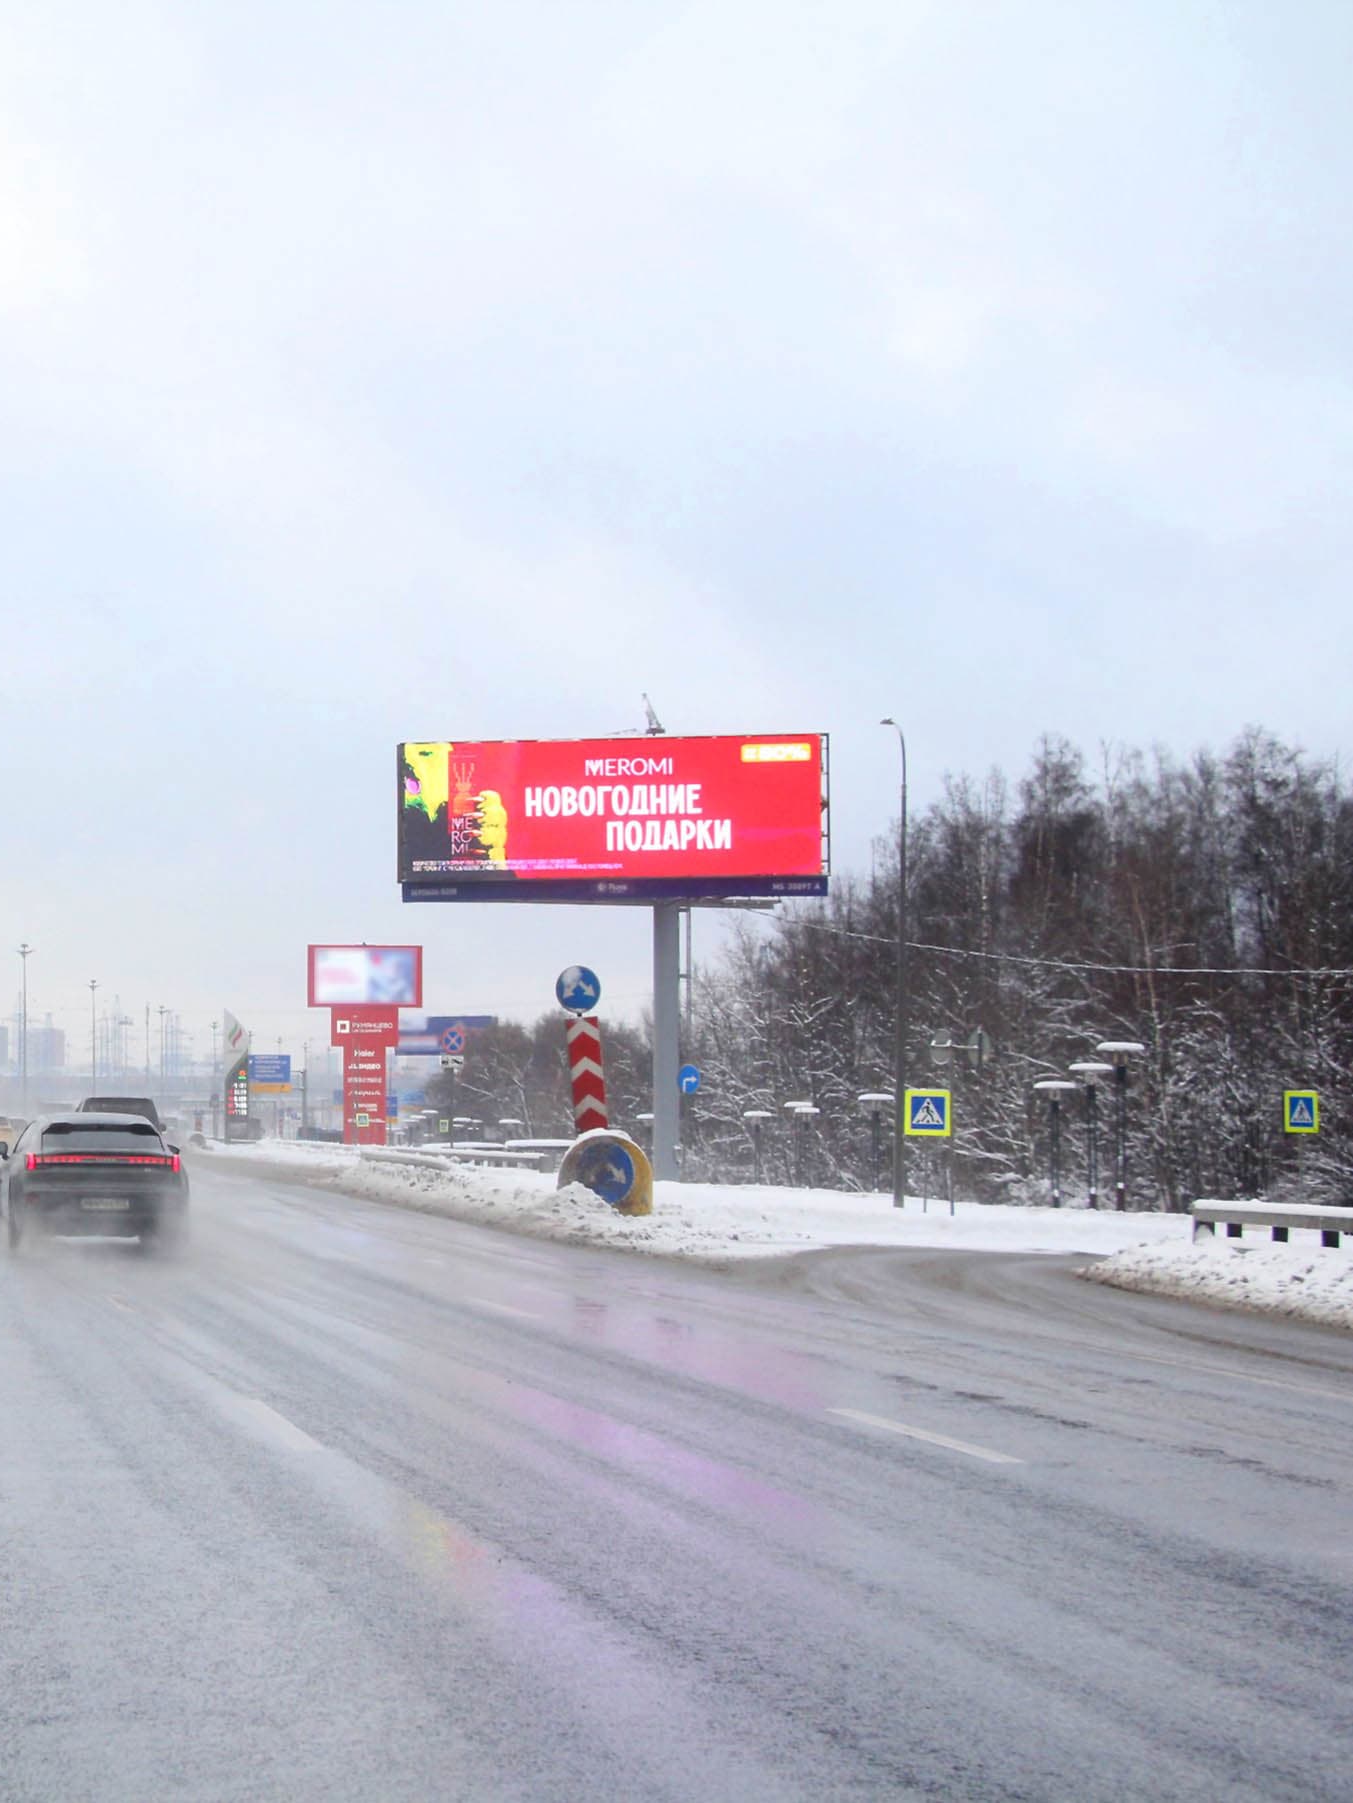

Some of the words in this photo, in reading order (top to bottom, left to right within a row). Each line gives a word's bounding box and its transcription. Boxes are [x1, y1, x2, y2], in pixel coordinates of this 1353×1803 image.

[585, 757, 673, 776] MEROMI
[524, 784, 703, 817] НОВОГОДНИЕ
[606, 819, 732, 852] ПОДАРКИ
